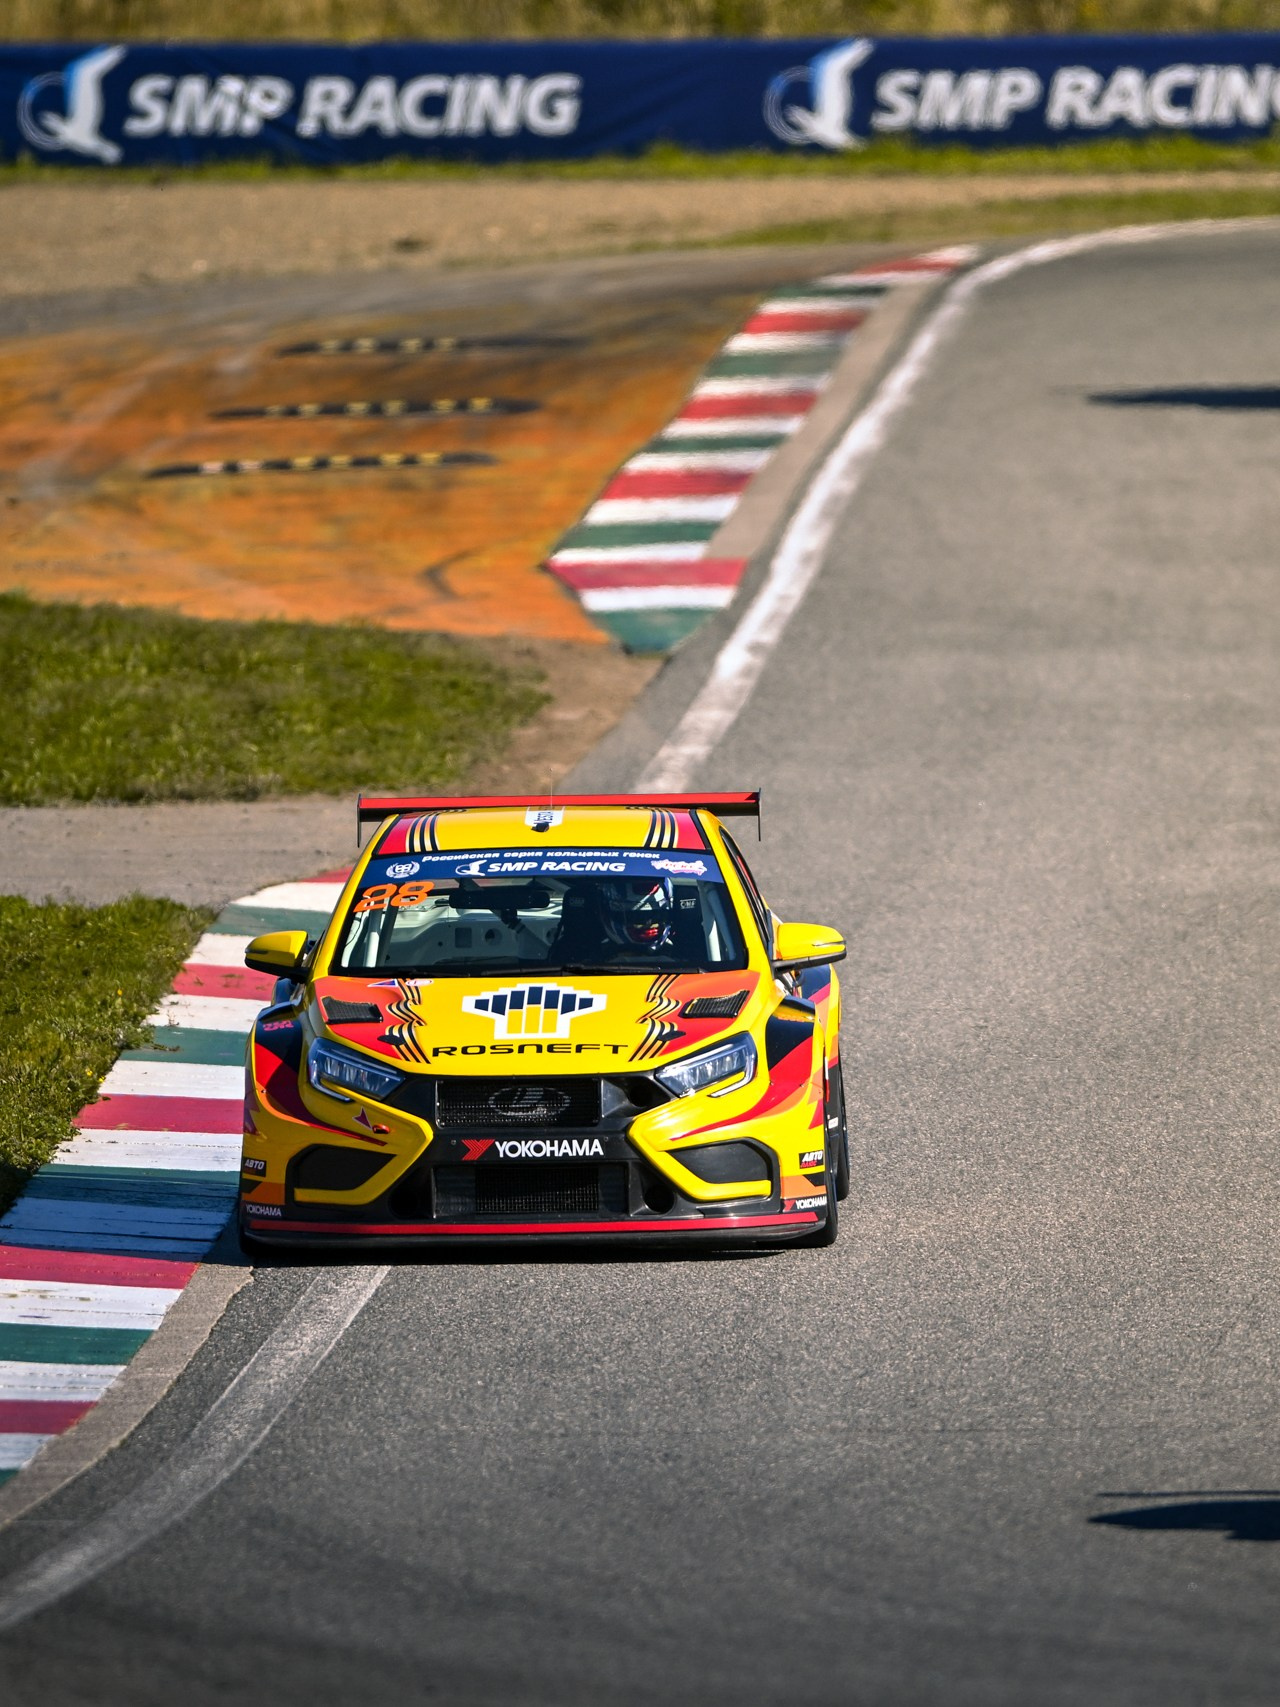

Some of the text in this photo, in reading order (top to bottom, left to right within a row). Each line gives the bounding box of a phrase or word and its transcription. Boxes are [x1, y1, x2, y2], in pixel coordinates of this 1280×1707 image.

[123, 74, 583, 137] SMP RACING
[870, 66, 1042, 132] SMP
[487, 861, 626, 873] SMP RACING
[353, 880, 434, 912] 28
[432, 1043, 629, 1058] ROSNEFT
[495, 1138, 604, 1158] YOKOHAMA
[245, 1203, 282, 1217] YOKOHAMA
